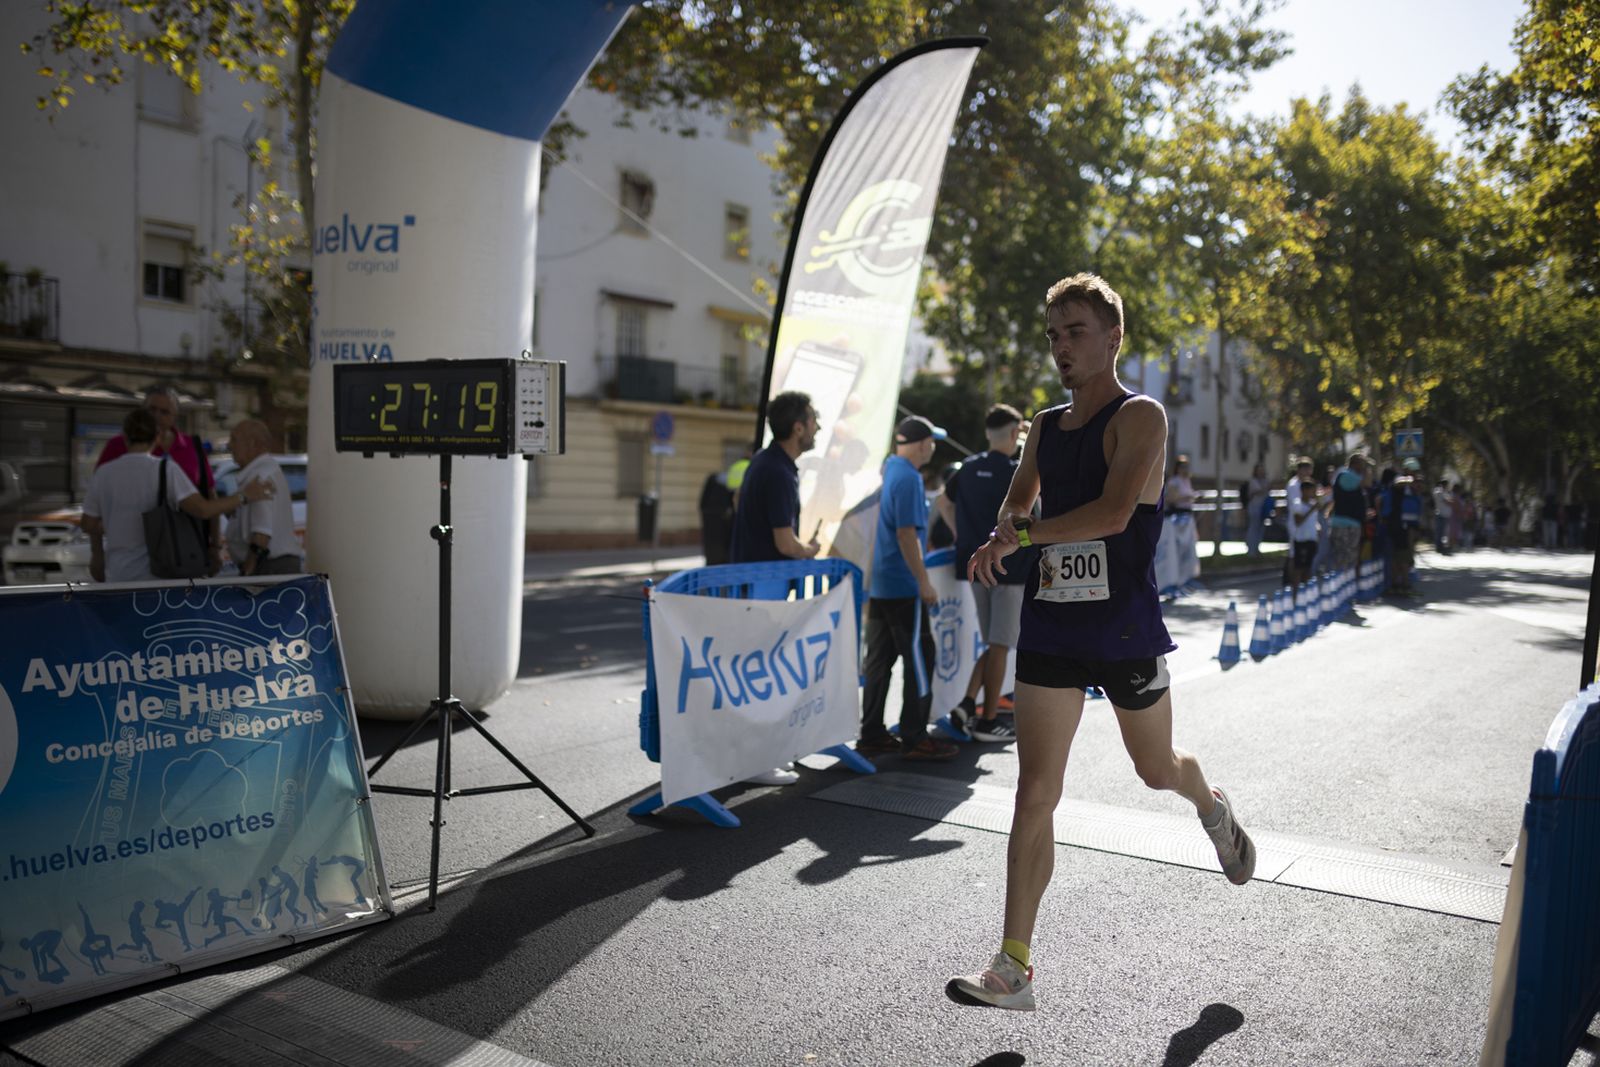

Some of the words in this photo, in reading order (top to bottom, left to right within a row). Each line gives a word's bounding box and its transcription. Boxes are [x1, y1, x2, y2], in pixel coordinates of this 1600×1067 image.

[347, 258, 399, 274] original
[319, 342, 394, 361] HUELVA
[1060, 553, 1100, 580] 500
[21, 637, 312, 698] Ayuntamiento
[677, 630, 832, 714] Huelva
[117, 691, 164, 723] de
[178, 673, 317, 716] Huelva
[46, 725, 177, 764] Concejalía
[184, 725, 213, 745] de
[220, 708, 324, 740] Deportes
